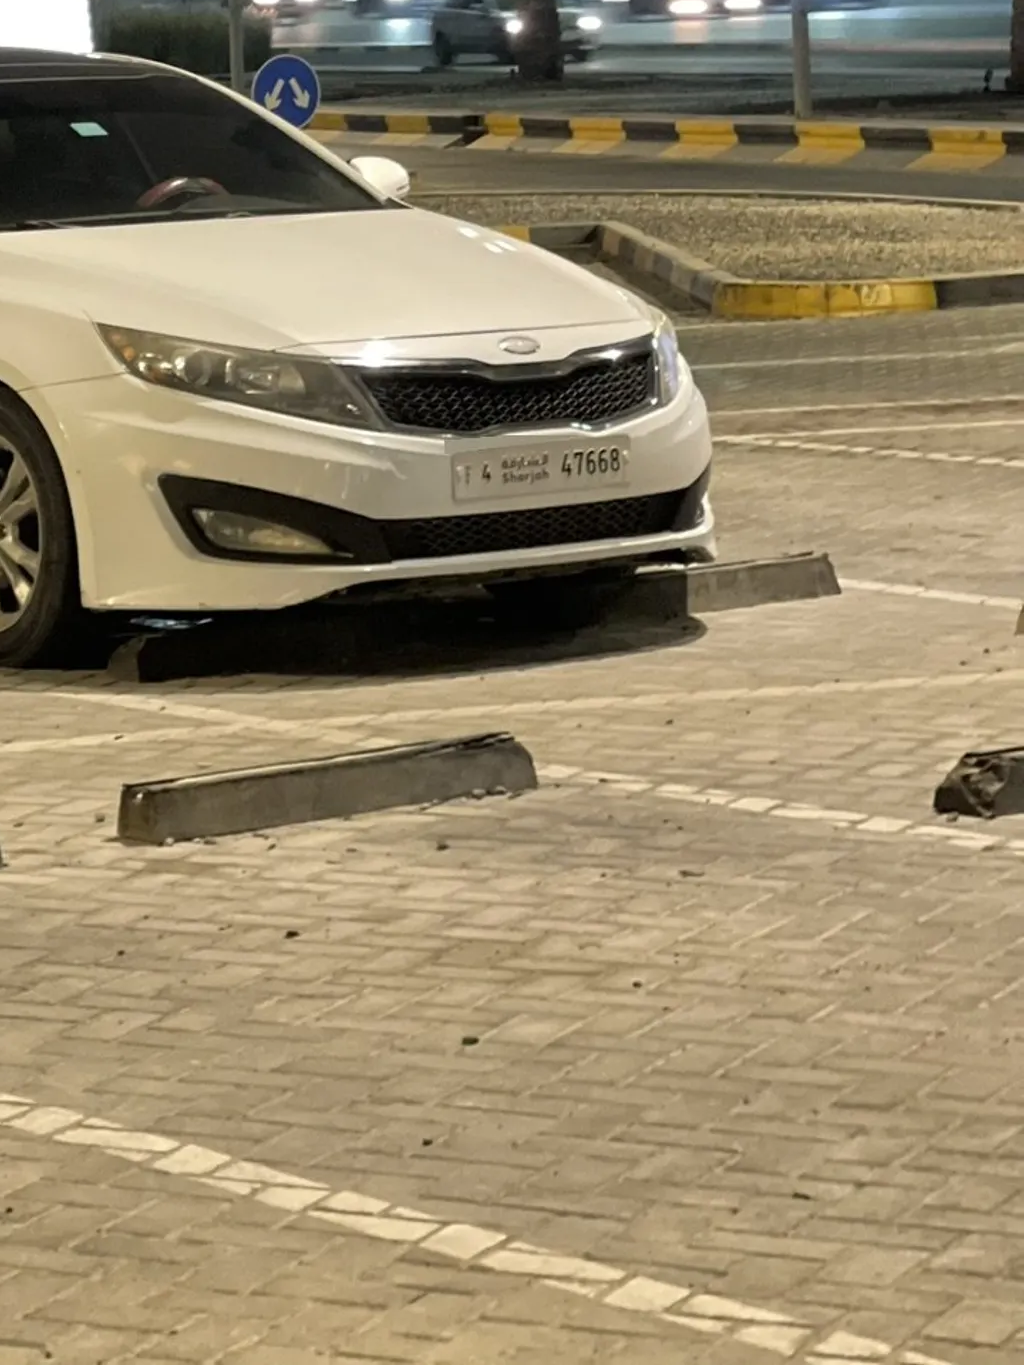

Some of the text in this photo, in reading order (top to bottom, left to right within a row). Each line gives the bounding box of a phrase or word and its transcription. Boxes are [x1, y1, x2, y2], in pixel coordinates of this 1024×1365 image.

[561, 446, 621, 477] 47668
[481, 463, 492, 483] 4
[502, 470, 550, 484] Sharjah
